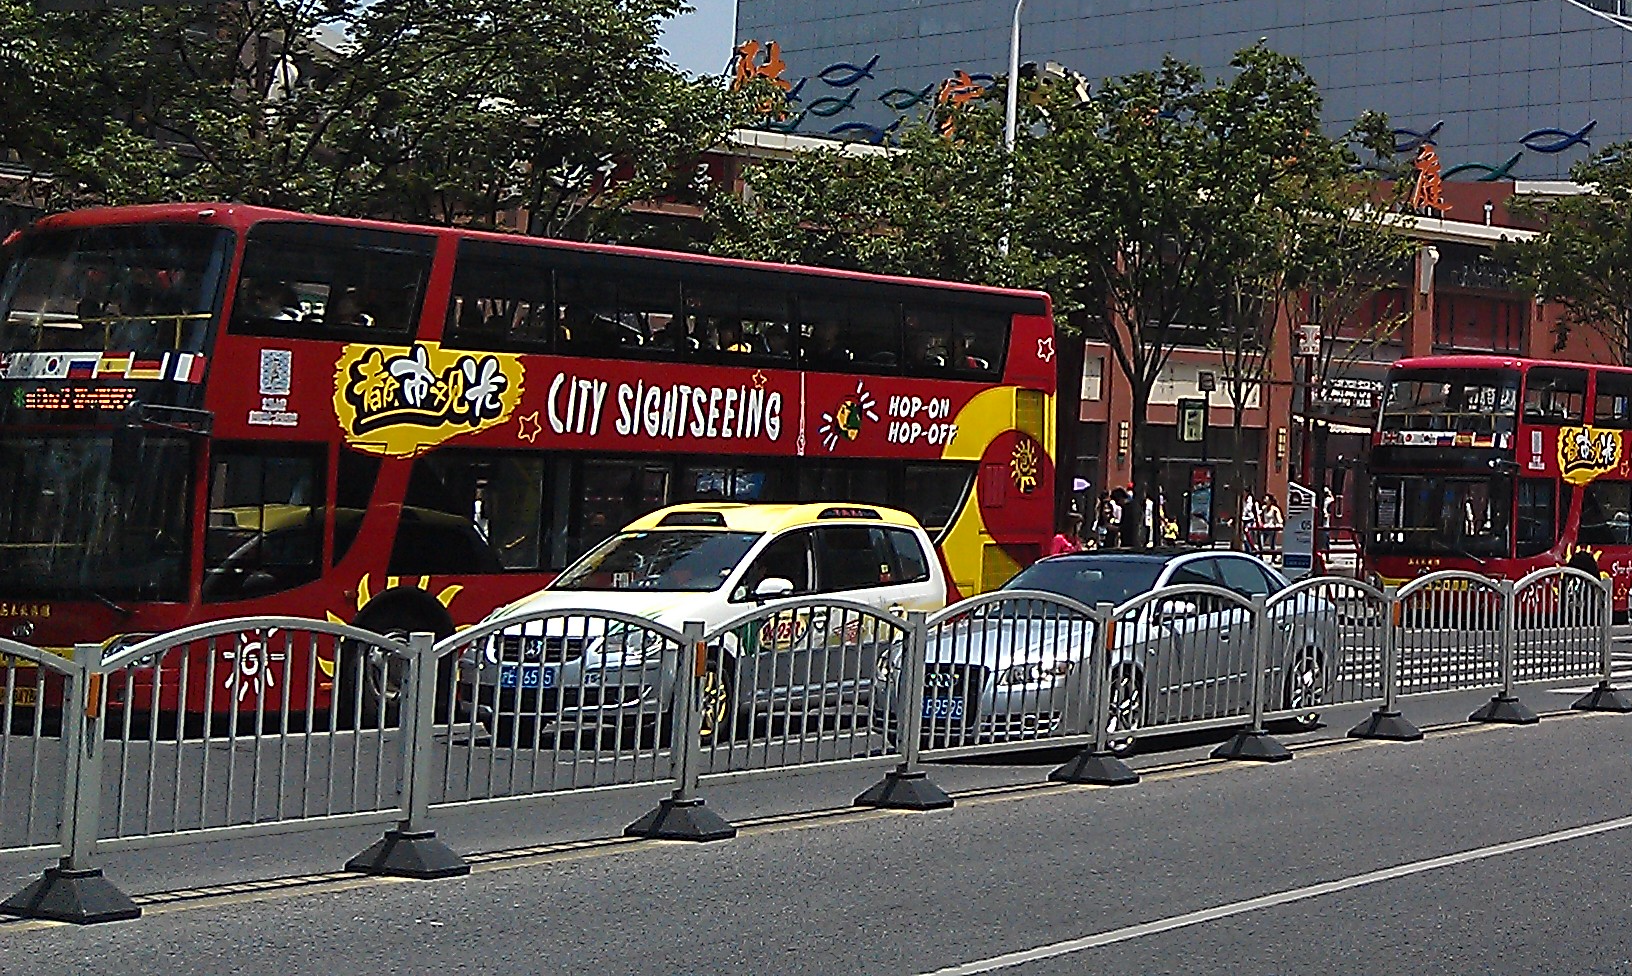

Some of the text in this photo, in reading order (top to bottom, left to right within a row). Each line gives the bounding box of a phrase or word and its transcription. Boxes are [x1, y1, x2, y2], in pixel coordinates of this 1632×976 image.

[353, 346, 506, 424] 都市观光
[547, 372, 781, 441] CITY SIGHTSEEING
[888, 395, 950, 419] HOP-ON
[887, 421, 960, 445] HOP-OFF
